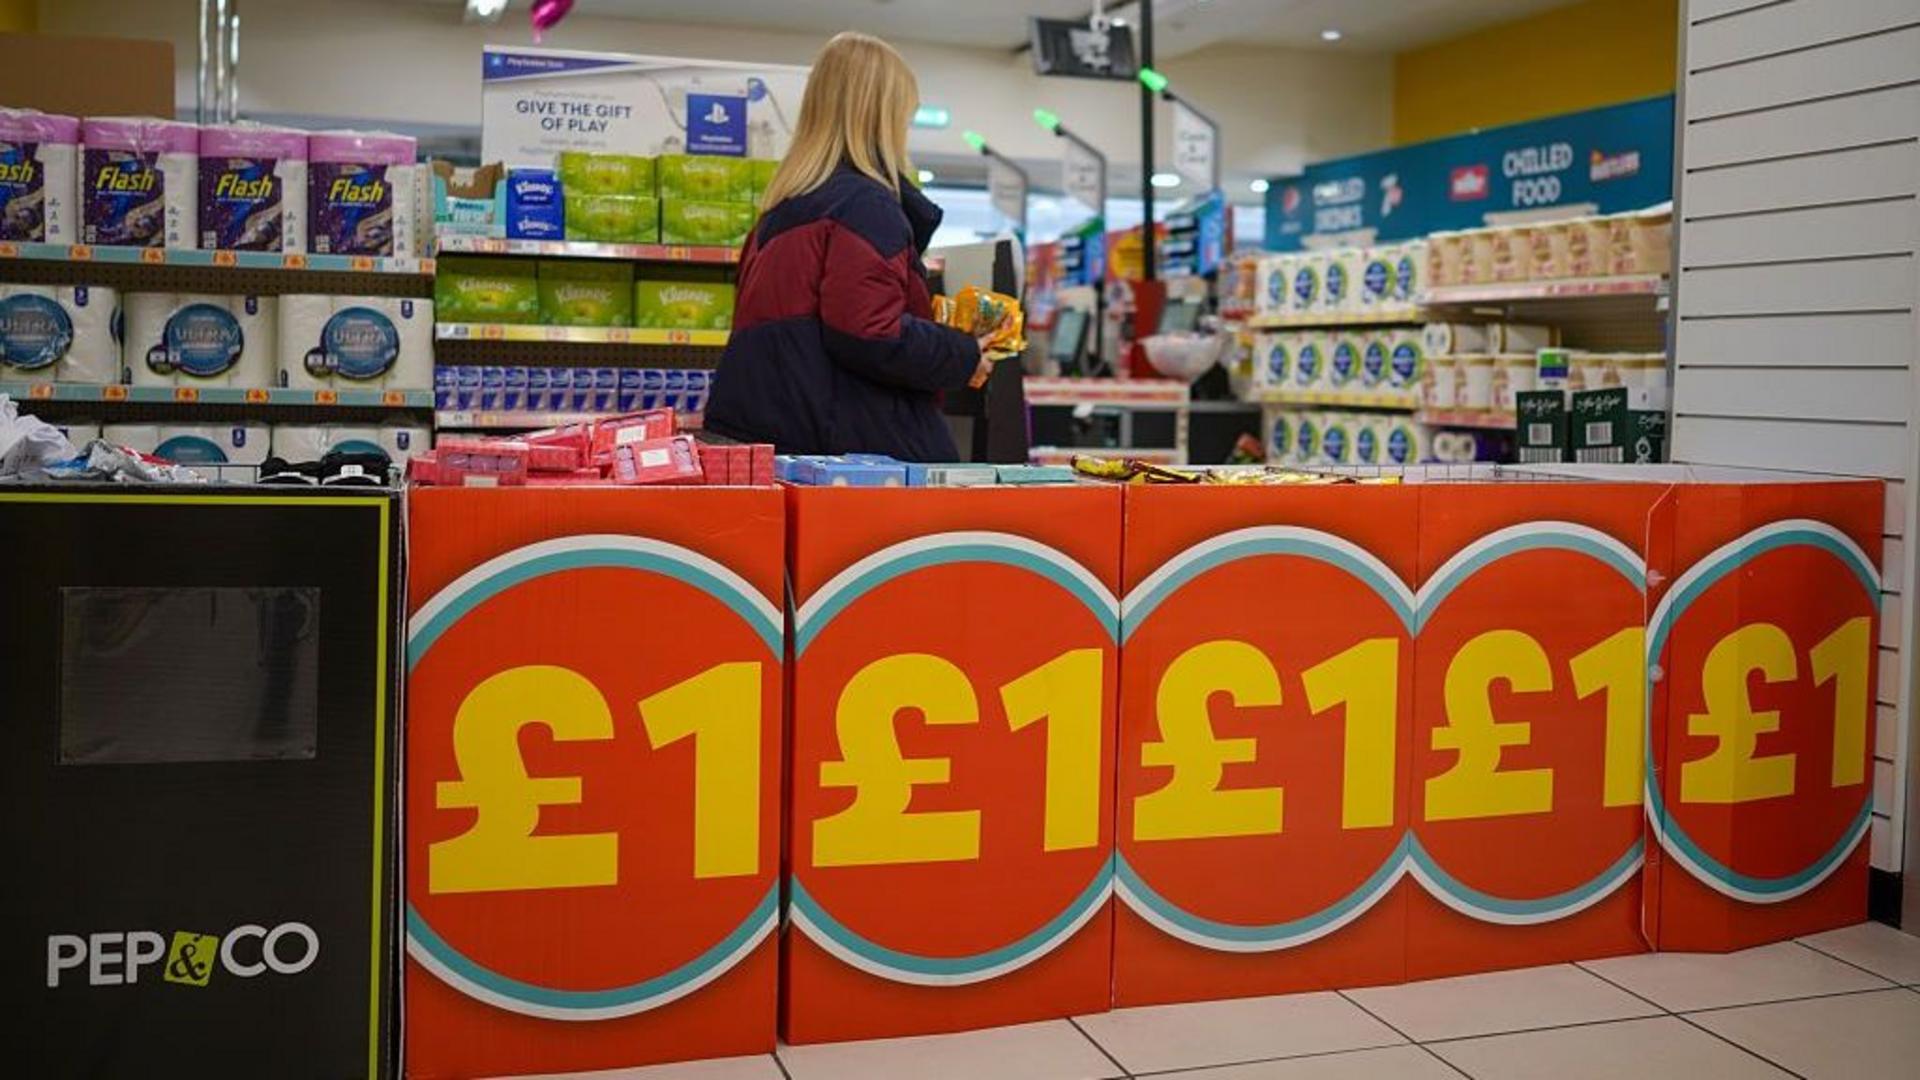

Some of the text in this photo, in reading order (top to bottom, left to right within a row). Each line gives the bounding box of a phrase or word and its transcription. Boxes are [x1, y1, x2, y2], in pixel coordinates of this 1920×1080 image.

[516, 99, 632, 119] GIVE THE GIFT
[541, 117, 608, 133] OF PLAY
[0, 160, 34, 183] ash
[1503, 142, 1573, 178] CHILLED
[96, 165, 155, 191] Flash
[216, 173, 273, 198] Flash
[329, 178, 384, 203] Flash
[1512, 175, 1561, 207] FOOD
[1424, 626, 1646, 822] £1
[1680, 616, 1871, 803] £1
[1134, 638, 1398, 840] £1
[813, 649, 1102, 867] £1
[430, 662, 761, 894] £1
[47, 921, 320, 987] PEP&CO
